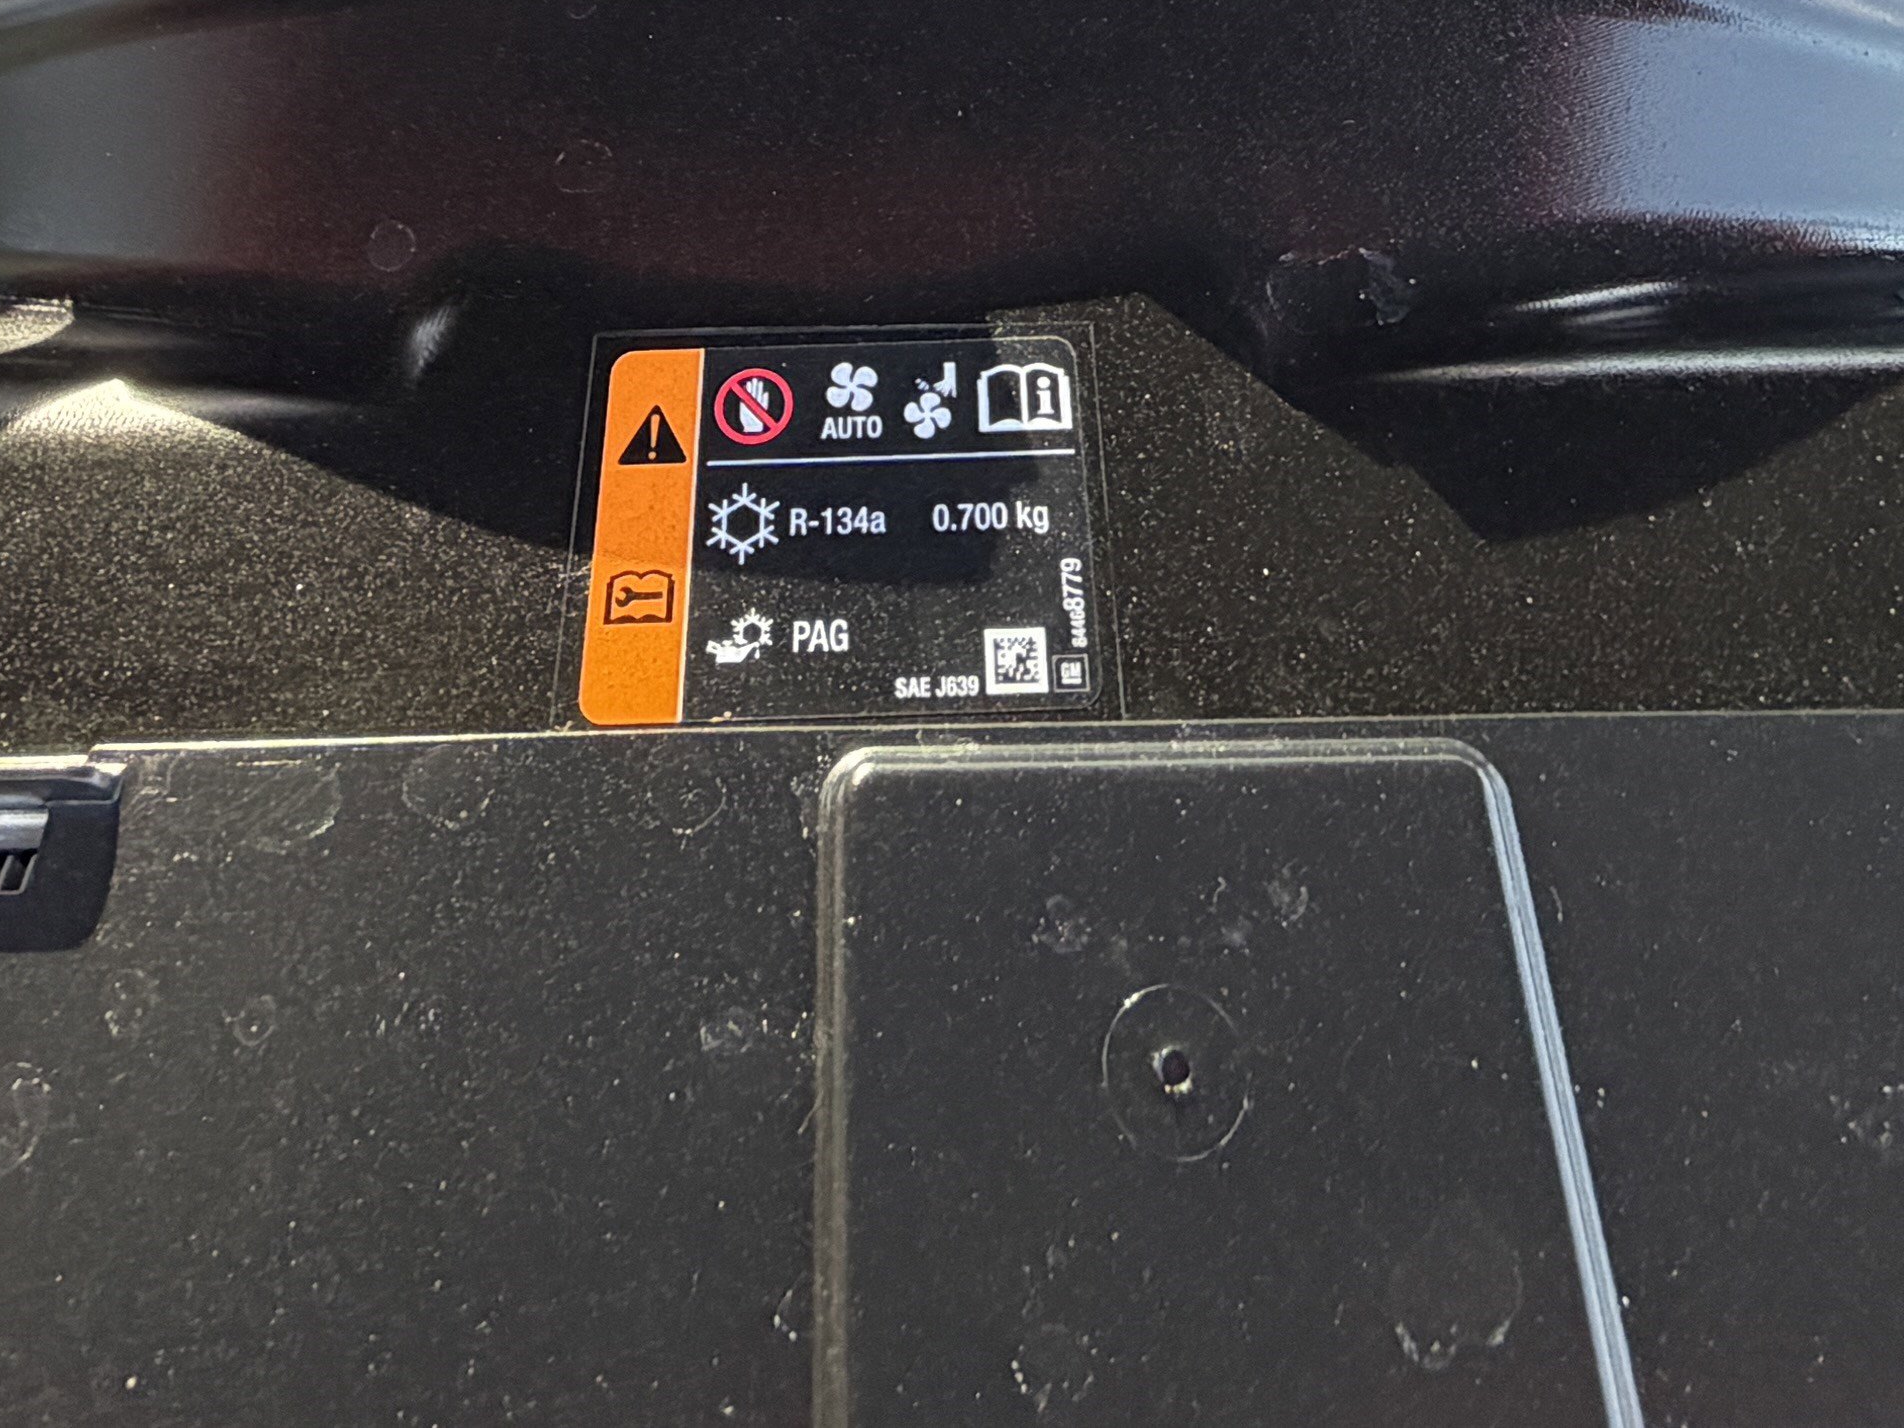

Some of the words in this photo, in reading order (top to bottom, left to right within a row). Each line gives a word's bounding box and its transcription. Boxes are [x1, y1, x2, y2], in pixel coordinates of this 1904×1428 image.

[821, 416, 883, 440] AUTO
[789, 506, 887, 537] R-134a
[932, 502, 1009, 532] 0.700
[1015, 499, 1050, 535] kg
[792, 619, 849, 653] PAG
[895, 675, 932, 699] SAE
[935, 674, 980, 698] J639
